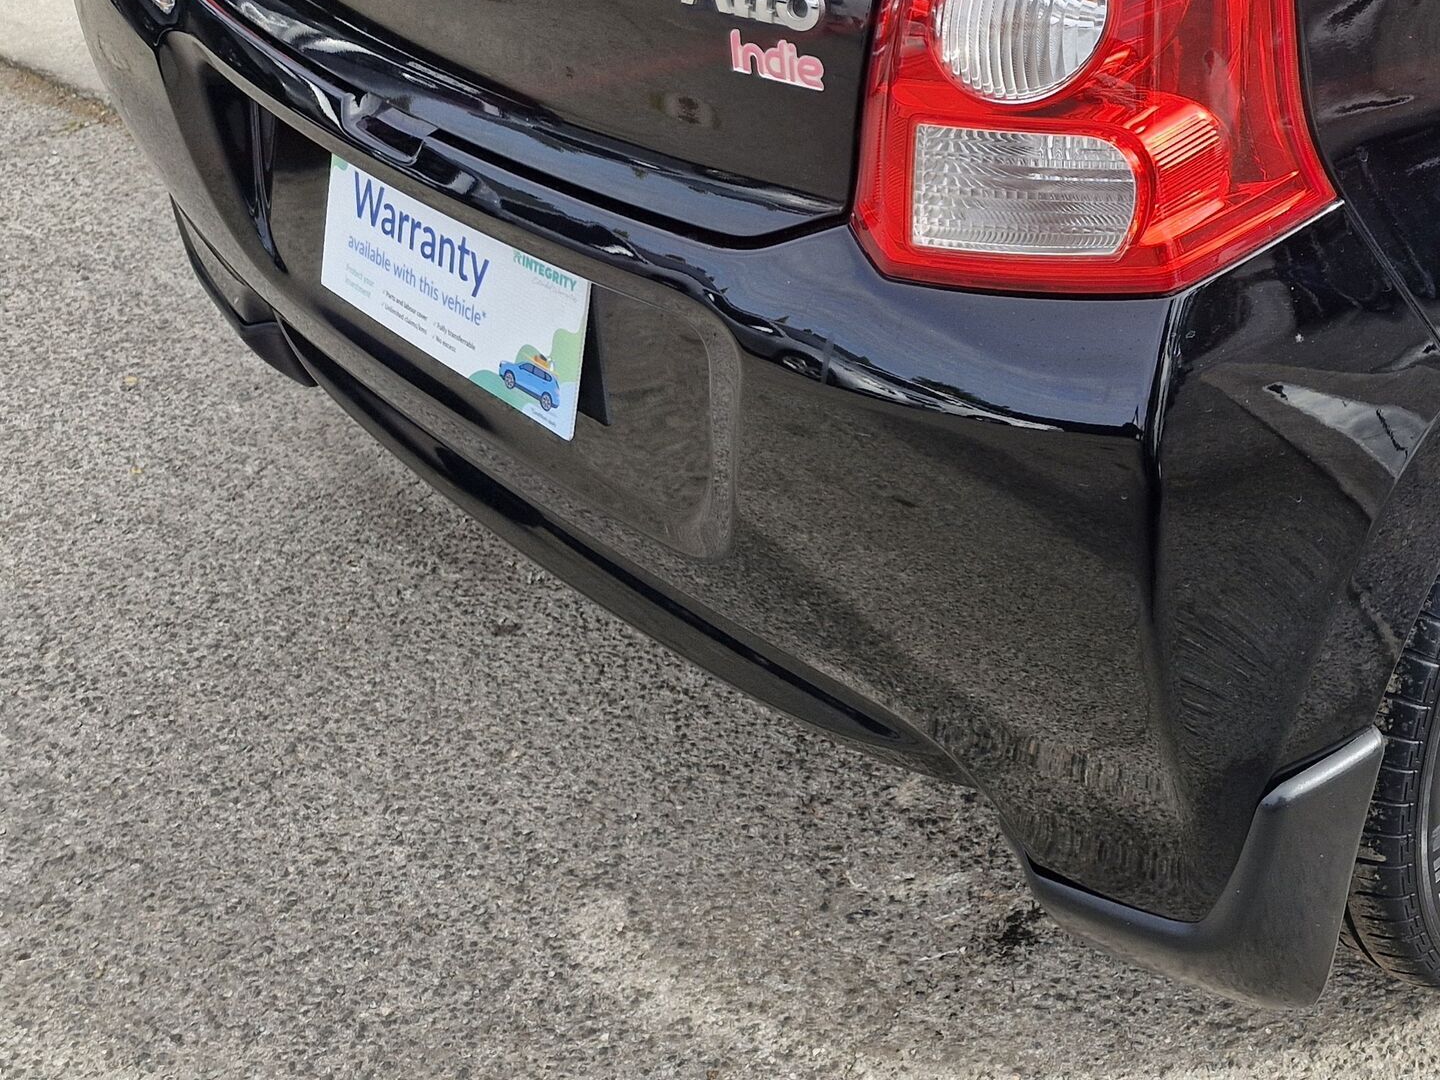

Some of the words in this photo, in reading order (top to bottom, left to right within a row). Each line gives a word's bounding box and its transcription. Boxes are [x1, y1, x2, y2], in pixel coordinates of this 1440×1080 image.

[730, 29, 825, 92] Indie
[354, 170, 490, 298] Warranty
[348, 234, 391, 272] available
[393, 264, 416, 288] with
[420, 274, 439, 301] this
[522, 254, 577, 292] INTEGRITY
